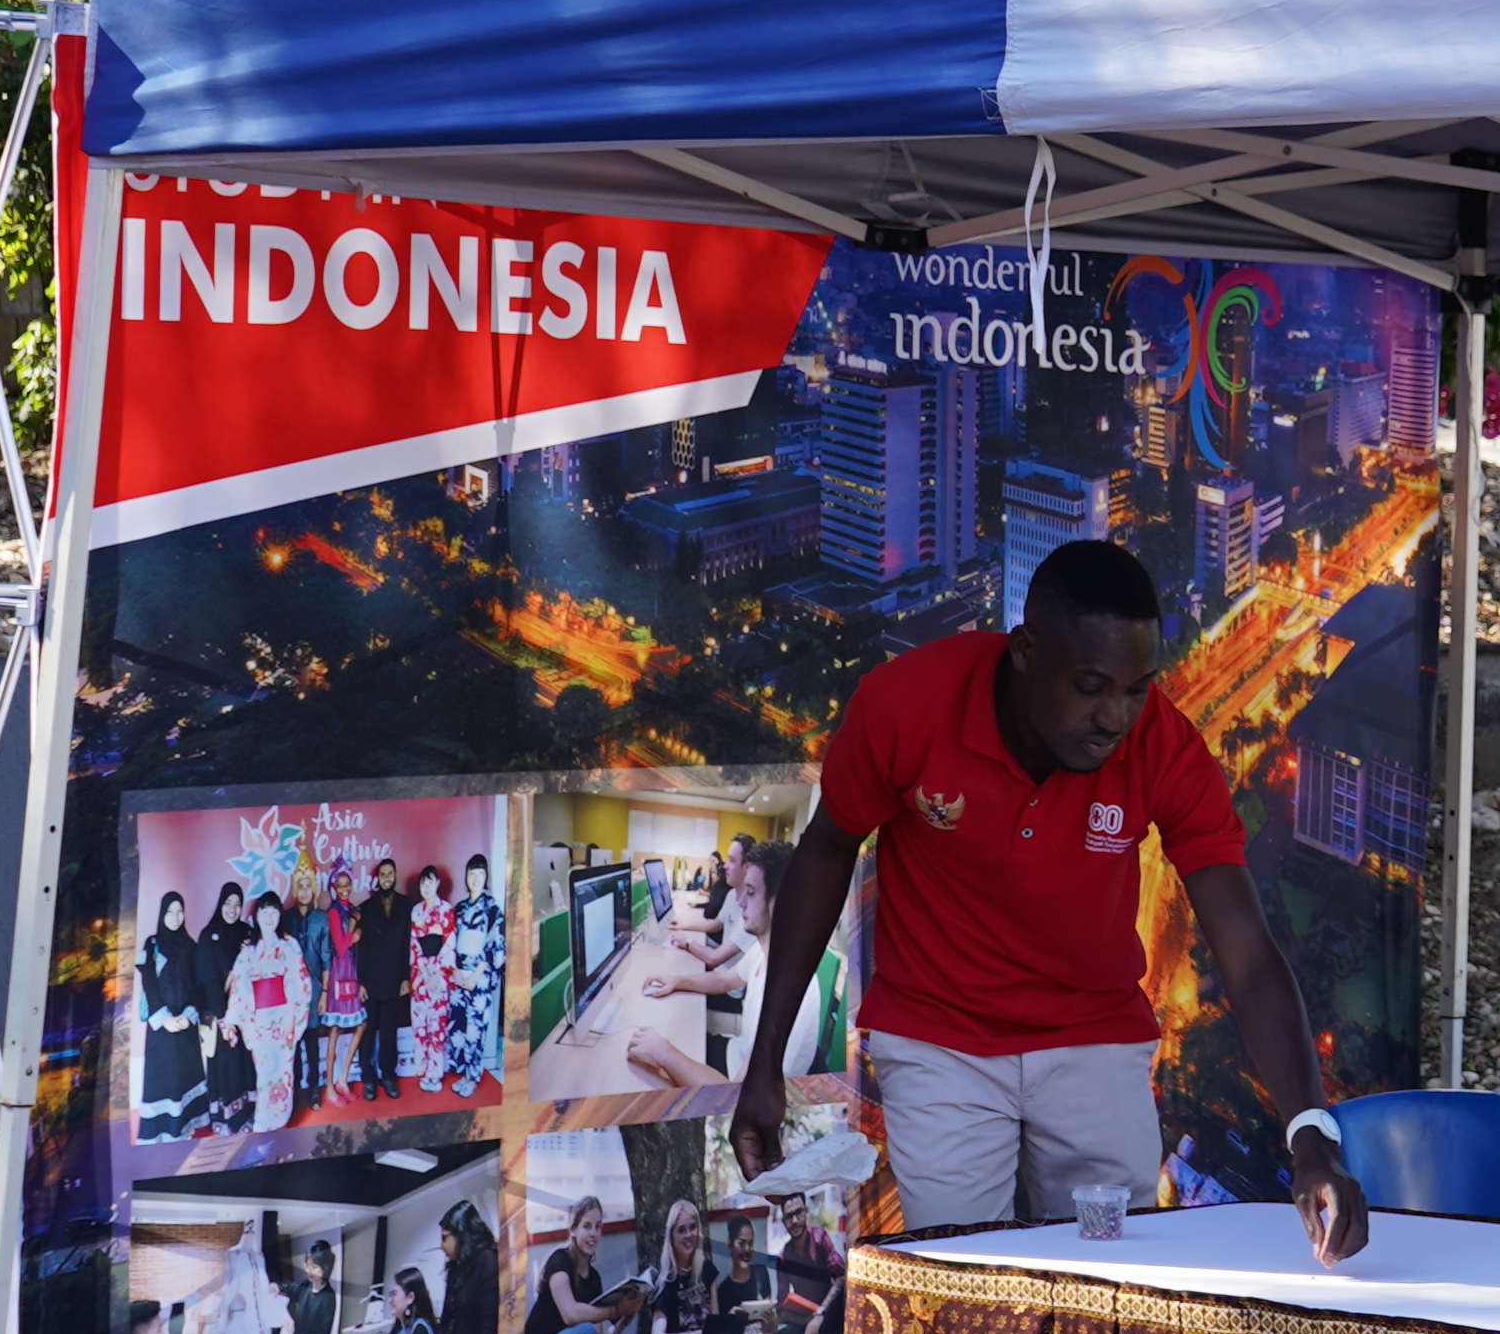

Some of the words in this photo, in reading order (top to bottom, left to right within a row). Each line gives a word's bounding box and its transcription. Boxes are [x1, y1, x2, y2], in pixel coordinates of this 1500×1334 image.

[121, 217, 688, 346] INDONESIA
[890, 296, 1152, 376] indonesia
[311, 801, 367, 837] Asia
[1088, 801, 1124, 836] 80
